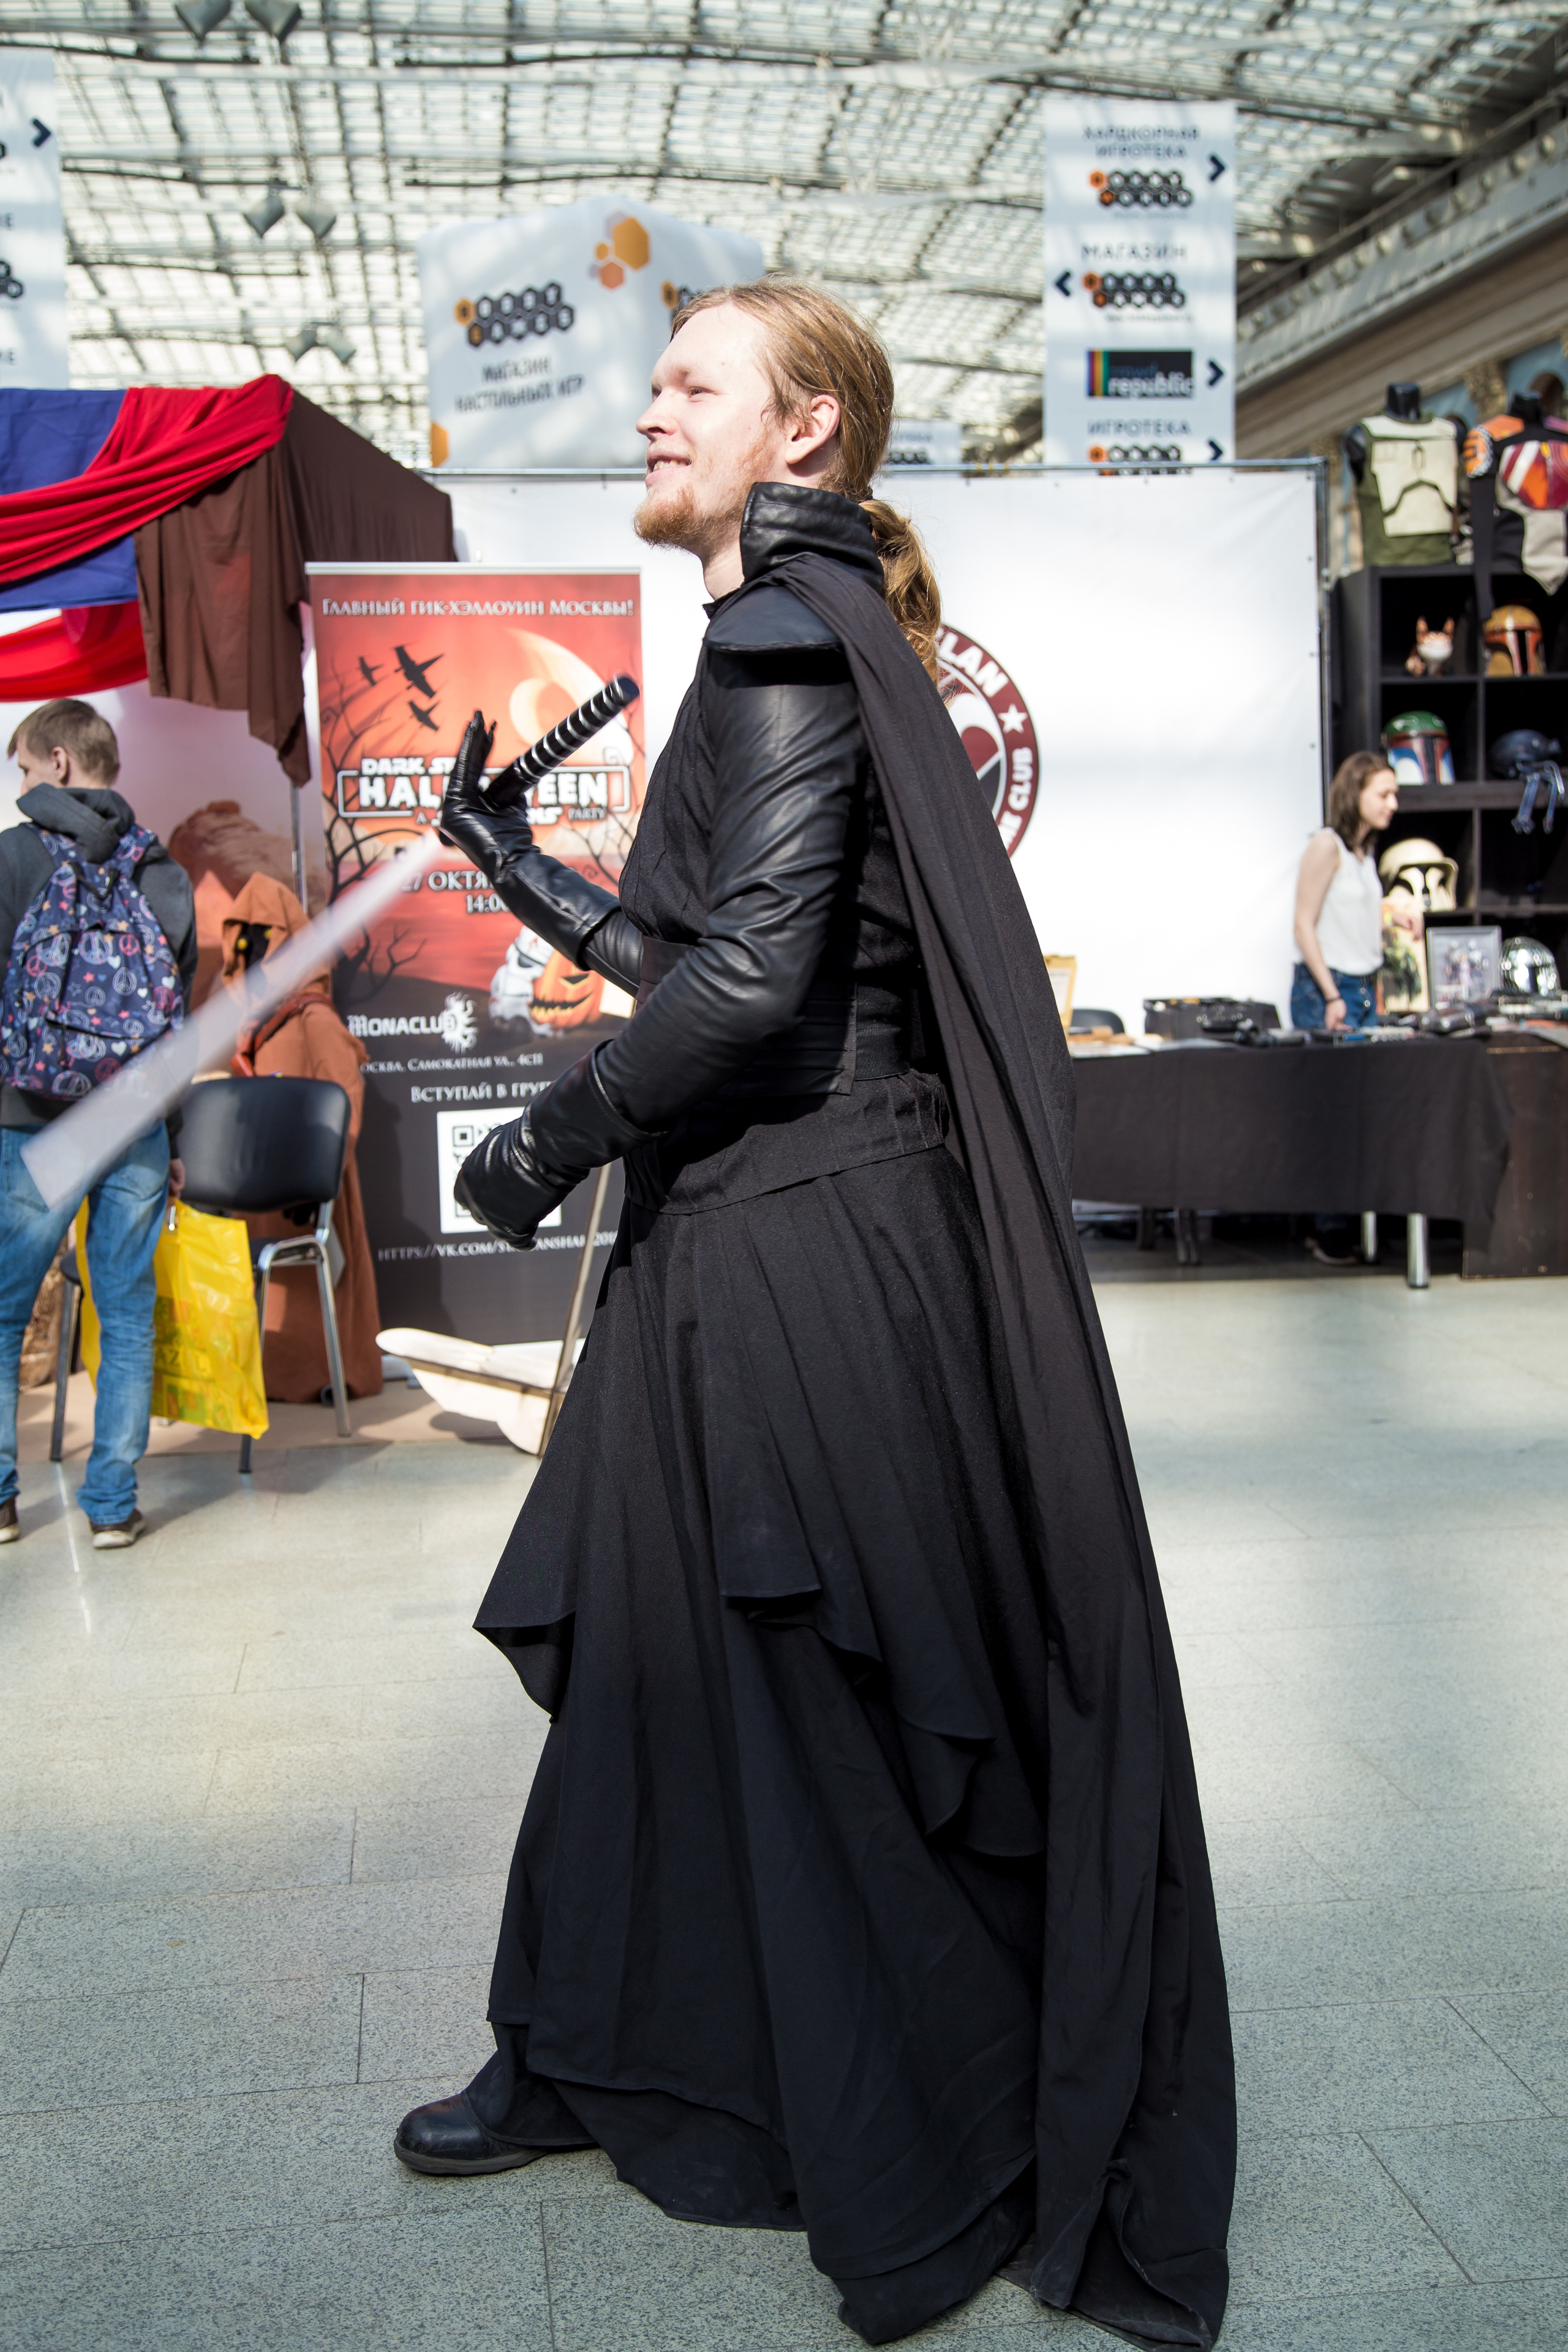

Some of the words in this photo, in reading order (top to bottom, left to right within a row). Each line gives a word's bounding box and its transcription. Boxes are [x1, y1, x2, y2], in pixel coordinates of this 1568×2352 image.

[1081, 243, 1187, 262] МАГАЗИН
[1108, 371, 1194, 398] republic
[1087, 419, 1192, 437] ИГРОТЕКА
[935, 626, 1009, 698] LAN
[361, 757, 426, 775] DARK
[1008, 747, 1033, 812] CLUB
[358, 771, 608, 809] HALEEN
[416, 811, 428, 824] A
[567, 807, 607, 821] PARTY
[428, 871, 495, 891] ОКТЯ
[511, 1081, 551, 1098] ГРУП
